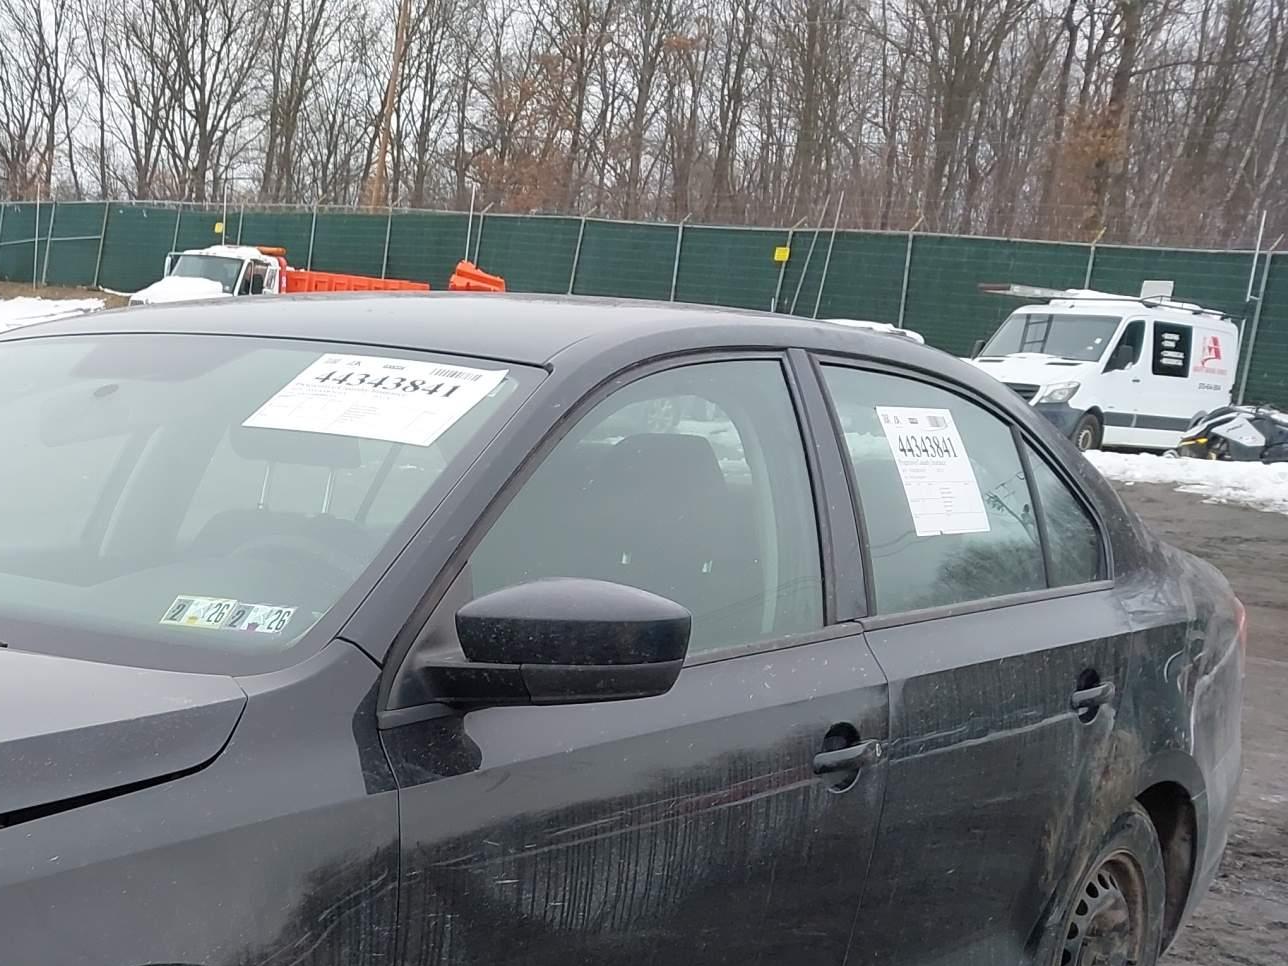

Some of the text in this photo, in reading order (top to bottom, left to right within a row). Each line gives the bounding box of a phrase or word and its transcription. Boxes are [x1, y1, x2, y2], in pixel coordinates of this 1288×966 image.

[314, 370, 461, 398] 44343841
[898, 434, 958, 458] 44343841
[168, 602, 230, 623] 2 26
[229, 609, 291, 630] 2 26
